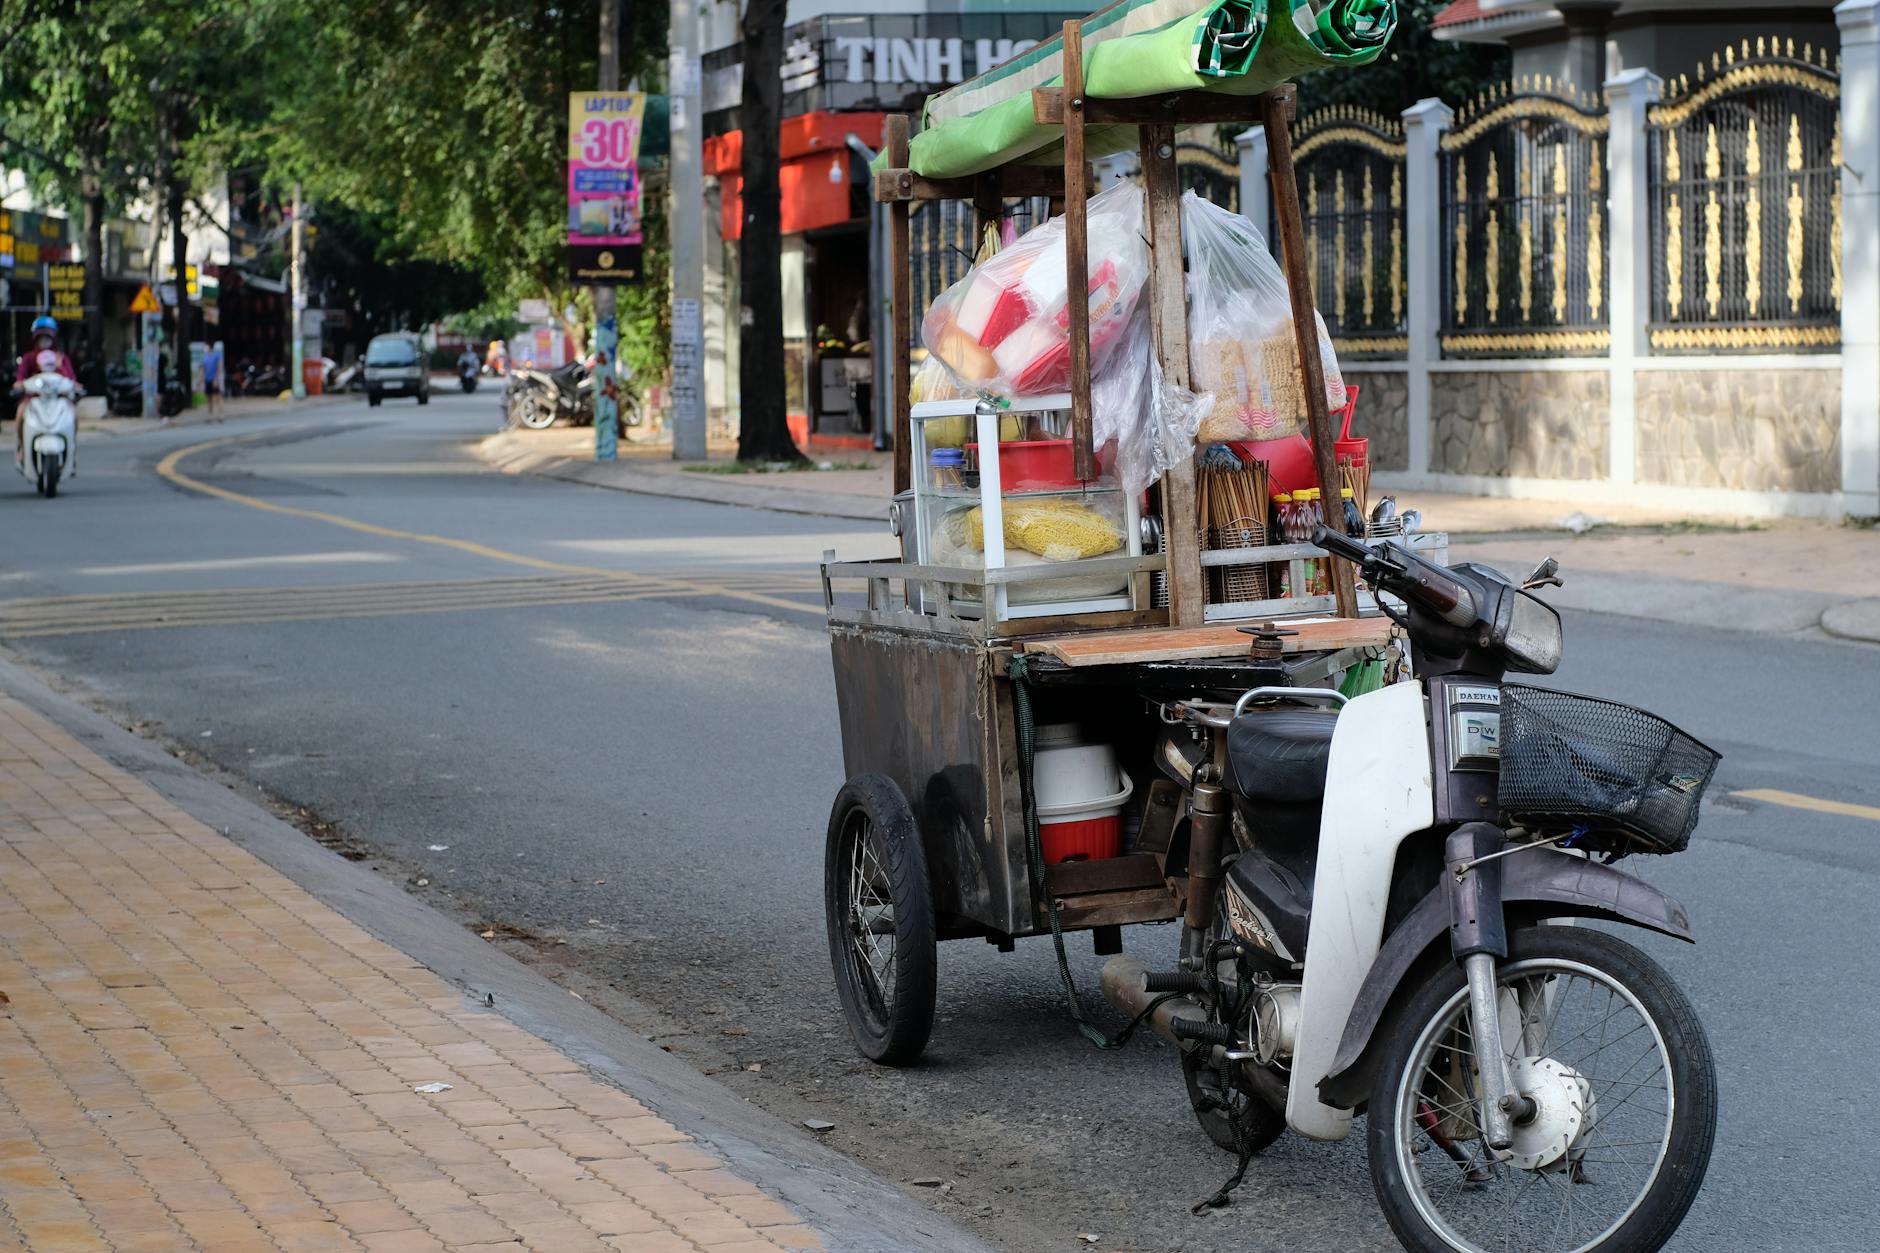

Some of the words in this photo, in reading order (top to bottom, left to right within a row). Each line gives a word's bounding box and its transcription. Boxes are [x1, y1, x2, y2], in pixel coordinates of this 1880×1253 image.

[836, 36, 964, 84] TINH
[975, 38, 1041, 76] H
[585, 97, 633, 112] LAPTOP
[1460, 693, 1498, 701] DAEHAN
